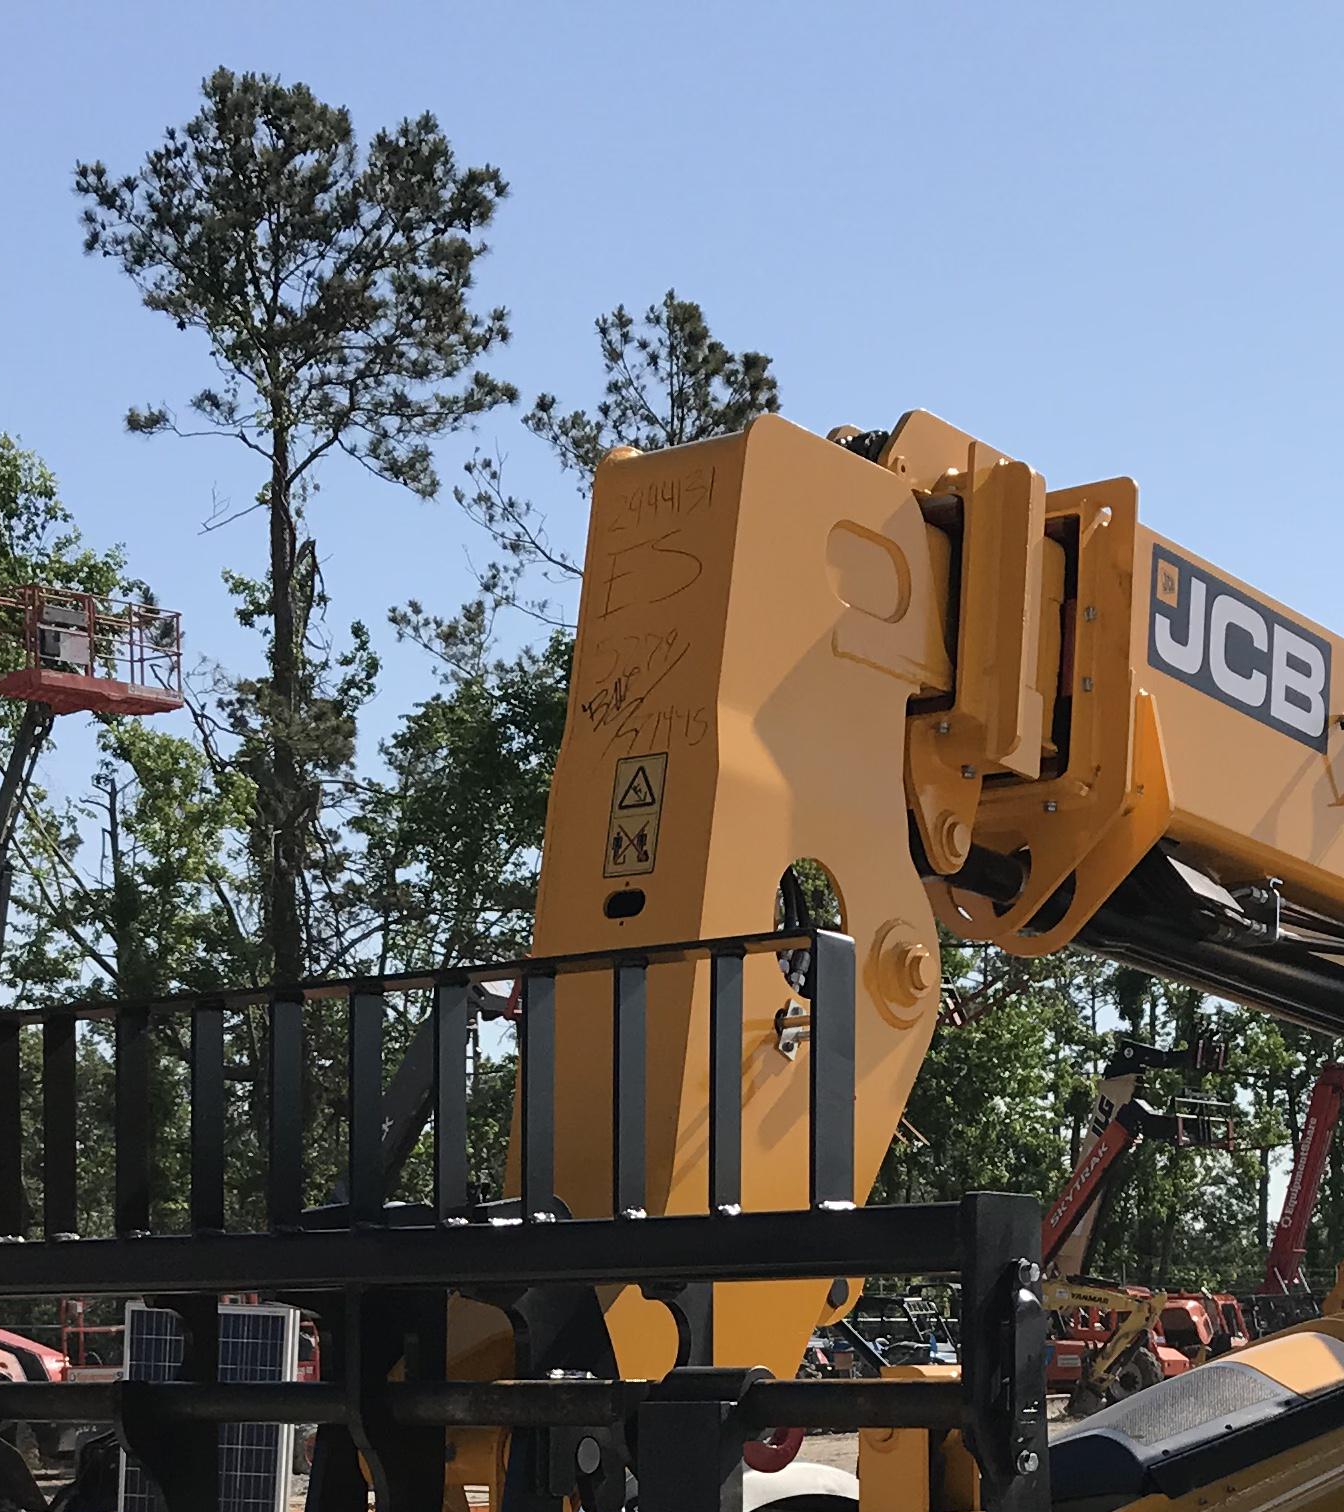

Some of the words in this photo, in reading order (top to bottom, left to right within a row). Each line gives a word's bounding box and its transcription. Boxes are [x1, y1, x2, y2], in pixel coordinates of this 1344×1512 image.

[1155, 576, 1326, 737] JCB
[1050, 1142, 1108, 1228] SKYTRAK
[1288, 1117, 1317, 1216] EquipmentShare
[1071, 1292, 1108, 1305] YANMAR
